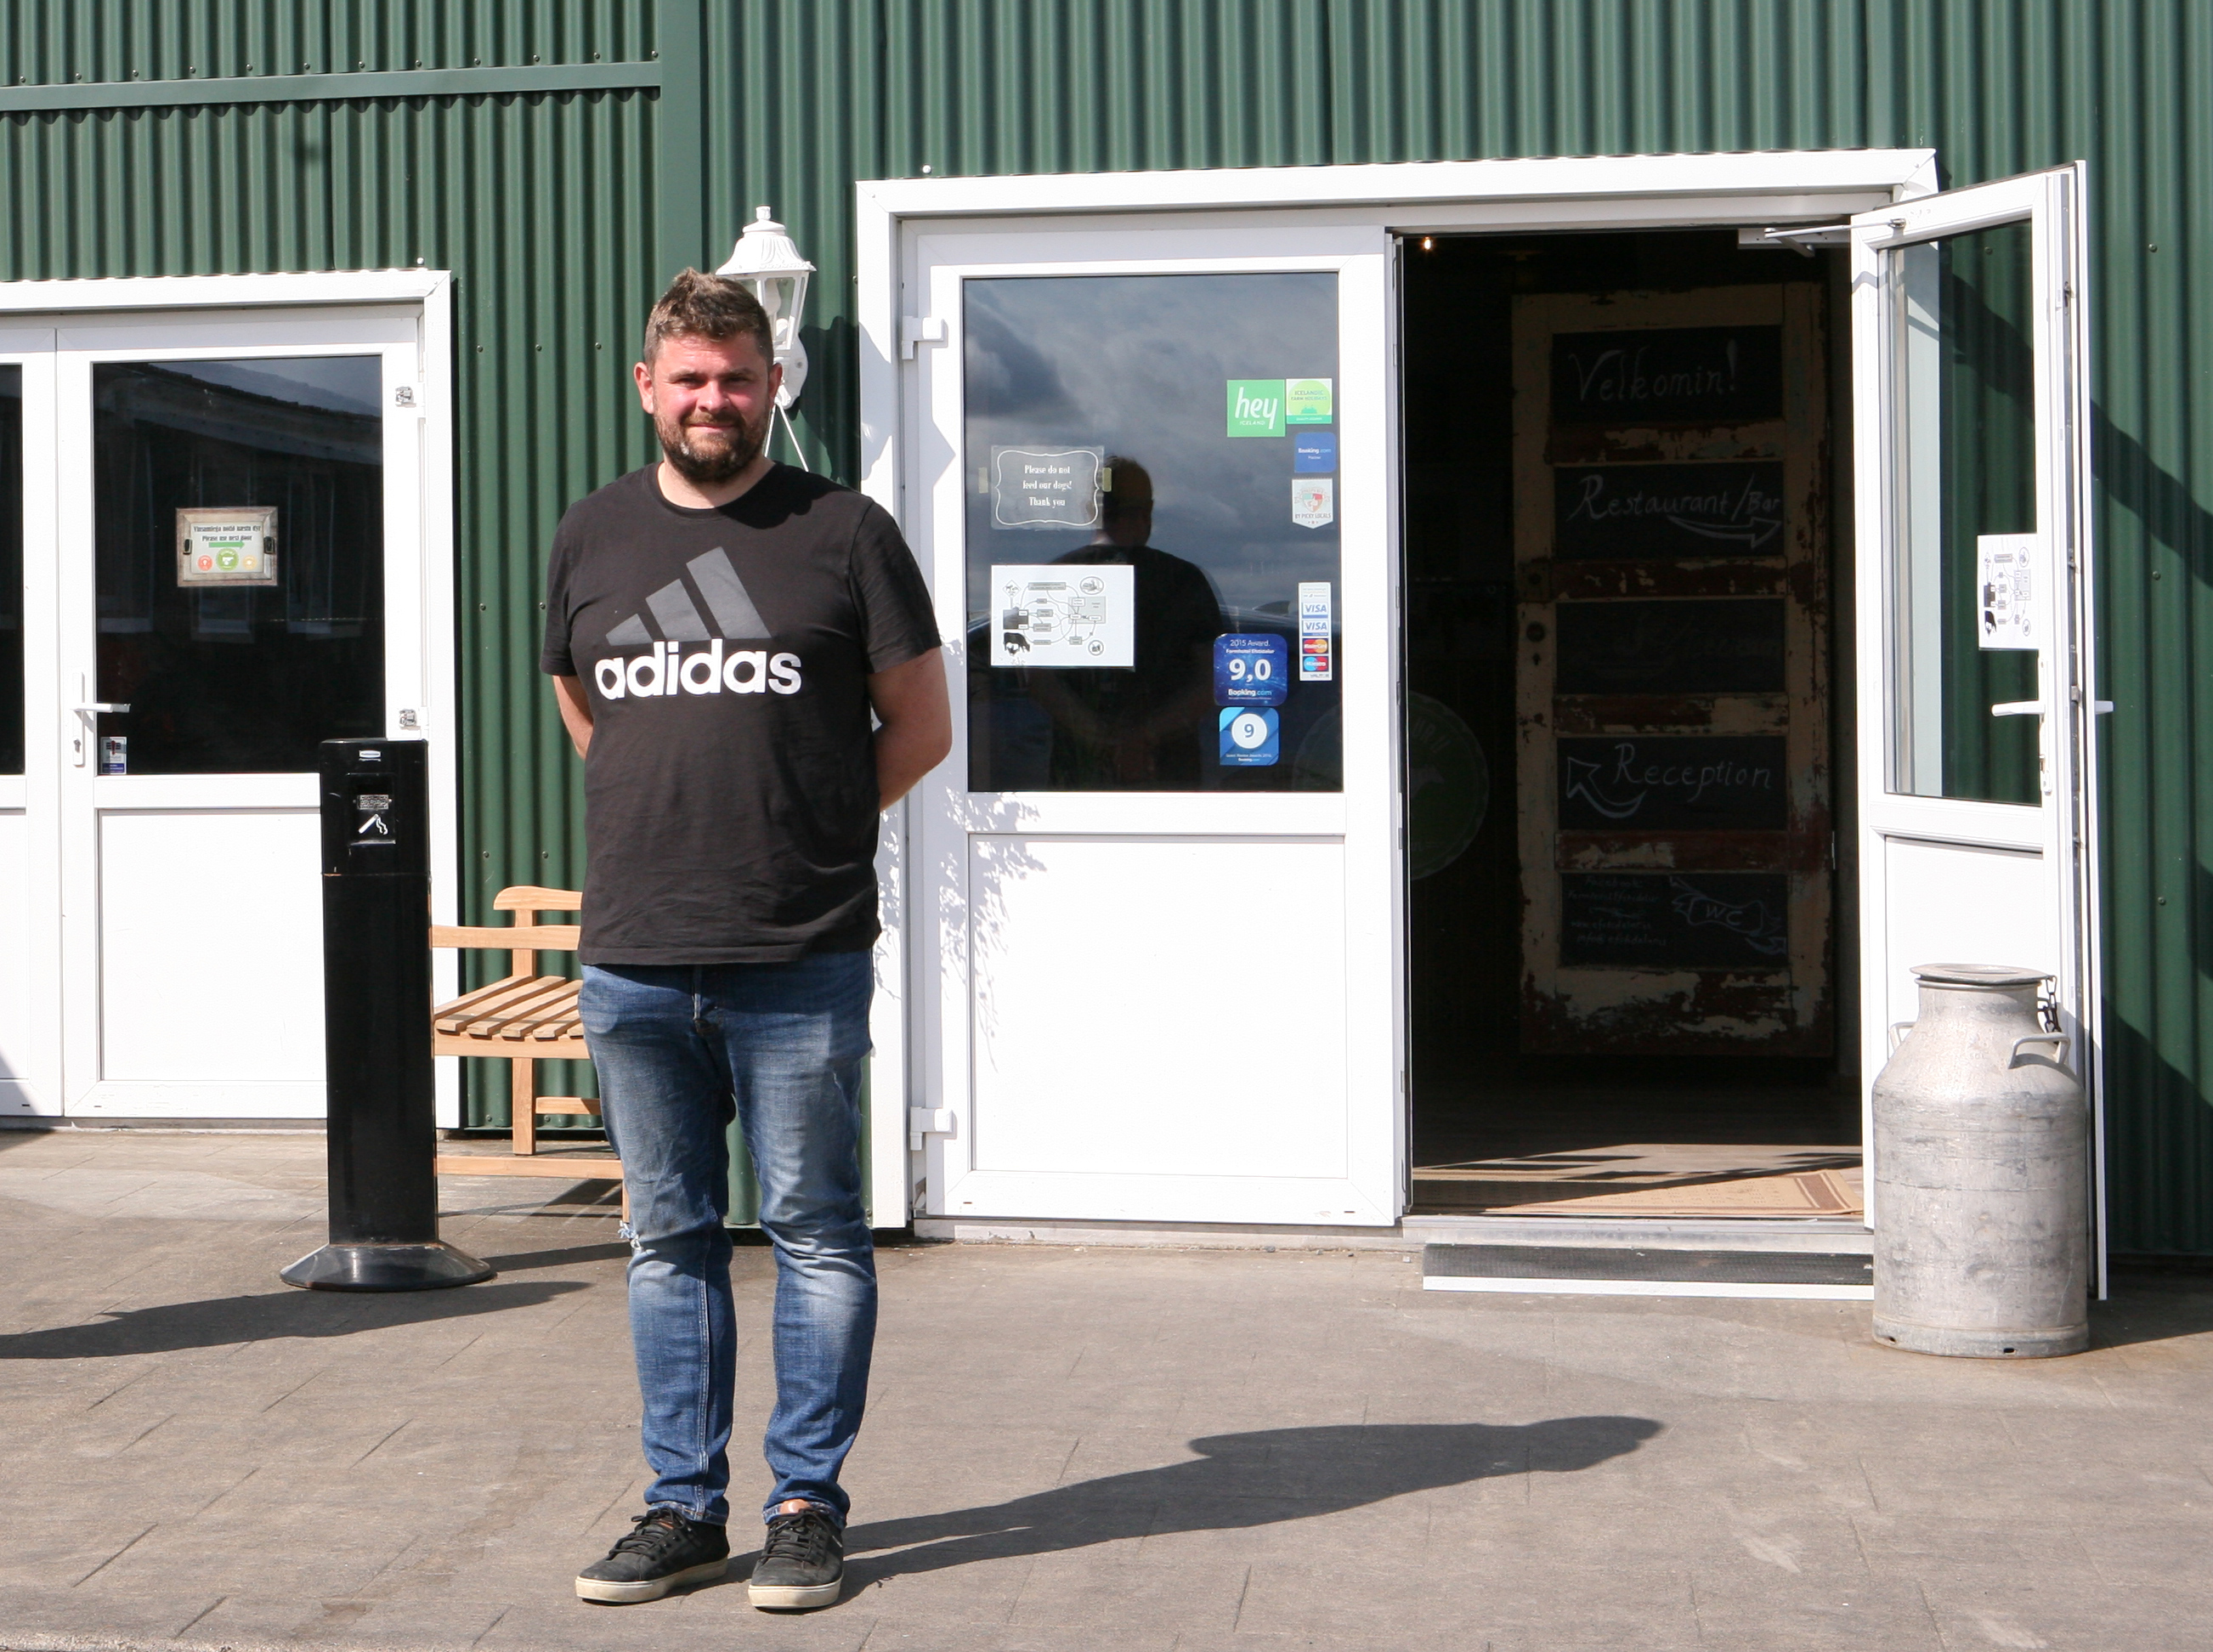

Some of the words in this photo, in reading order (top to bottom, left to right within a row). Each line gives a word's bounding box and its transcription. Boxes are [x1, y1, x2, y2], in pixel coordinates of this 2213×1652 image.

[1568, 338, 1739, 403] Velkomin!
[1235, 387, 1278, 430] hey
[1024, 465, 1046, 474] Please
[1048, 465, 1056, 474] do
[1059, 466, 1071, 474] not
[1022, 480, 1037, 489] feed
[1053, 480, 1073, 491] dogs!
[1028, 497, 1050, 506] Thank
[1052, 499, 1066, 508] you
[1305, 604, 1327, 613] VISA
[595, 638, 801, 700] adidas
[1229, 659, 1271, 682] 9,0
[1228, 688, 1272, 697] Booking.com
[1243, 723, 1254, 738] 9
[1613, 743, 1772, 803] Reception
[1705, 903, 1744, 926] WC
